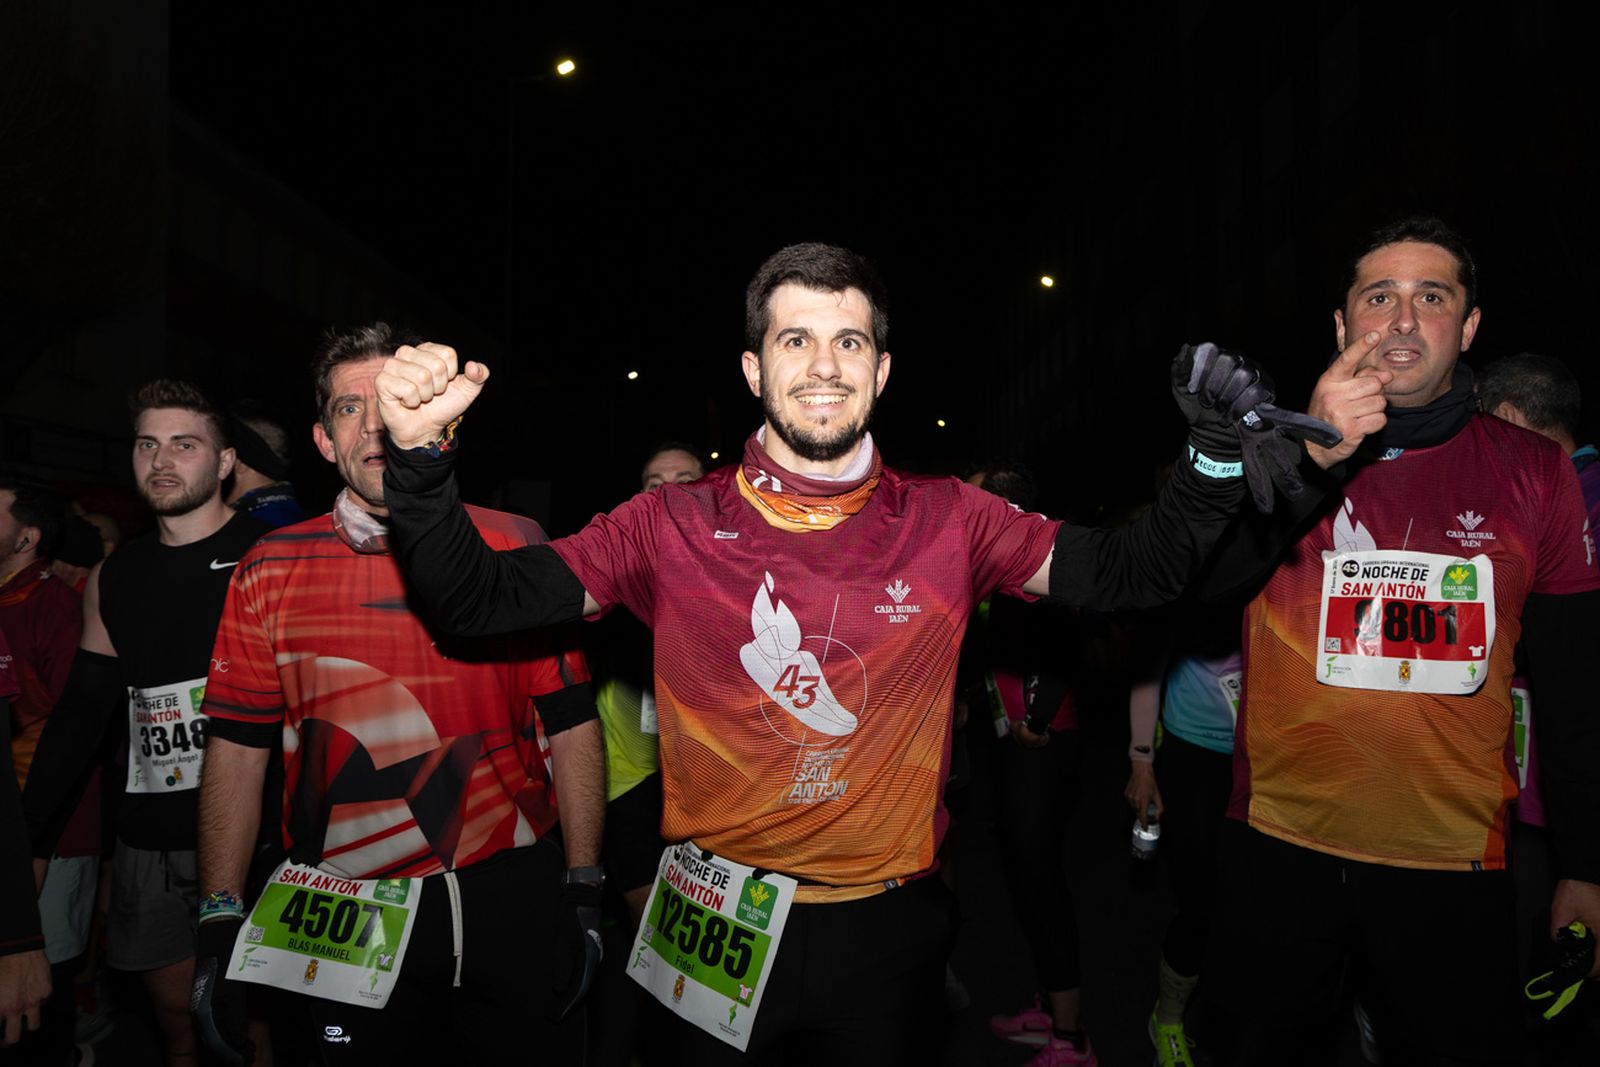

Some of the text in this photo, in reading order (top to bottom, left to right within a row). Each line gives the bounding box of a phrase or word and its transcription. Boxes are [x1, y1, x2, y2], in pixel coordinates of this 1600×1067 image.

[1446, 530, 1496, 541] CAJA RURAL
[1461, 540, 1481, 548] JAÉN
[1342, 562, 1359, 574] 43
[1361, 565, 1430, 582] NOCHE DE
[1341, 580, 1426, 600] SAN ANTÓN
[874, 604, 922, 614] CAJA RURAL
[889, 614, 909, 623] JAÉN
[1354, 599, 1457, 645] 9801
[773, 664, 821, 709] 43
[164, 696, 179, 708] DE
[140, 717, 209, 758] 3348
[152, 757, 176, 768] Miguel
[795, 766, 831, 782] SAN
[279, 868, 312, 888] SAN
[677, 854, 712, 883] NOCHE
[710, 870, 731, 890] DE
[665, 864, 682, 887] SAN
[679, 877, 726, 912] ANTÓN
[279, 889, 385, 949] 4507
[657, 887, 756, 980] 12585
[287, 937, 352, 961] BLAS MANUEL
[674, 955, 695, 974] Fidel
